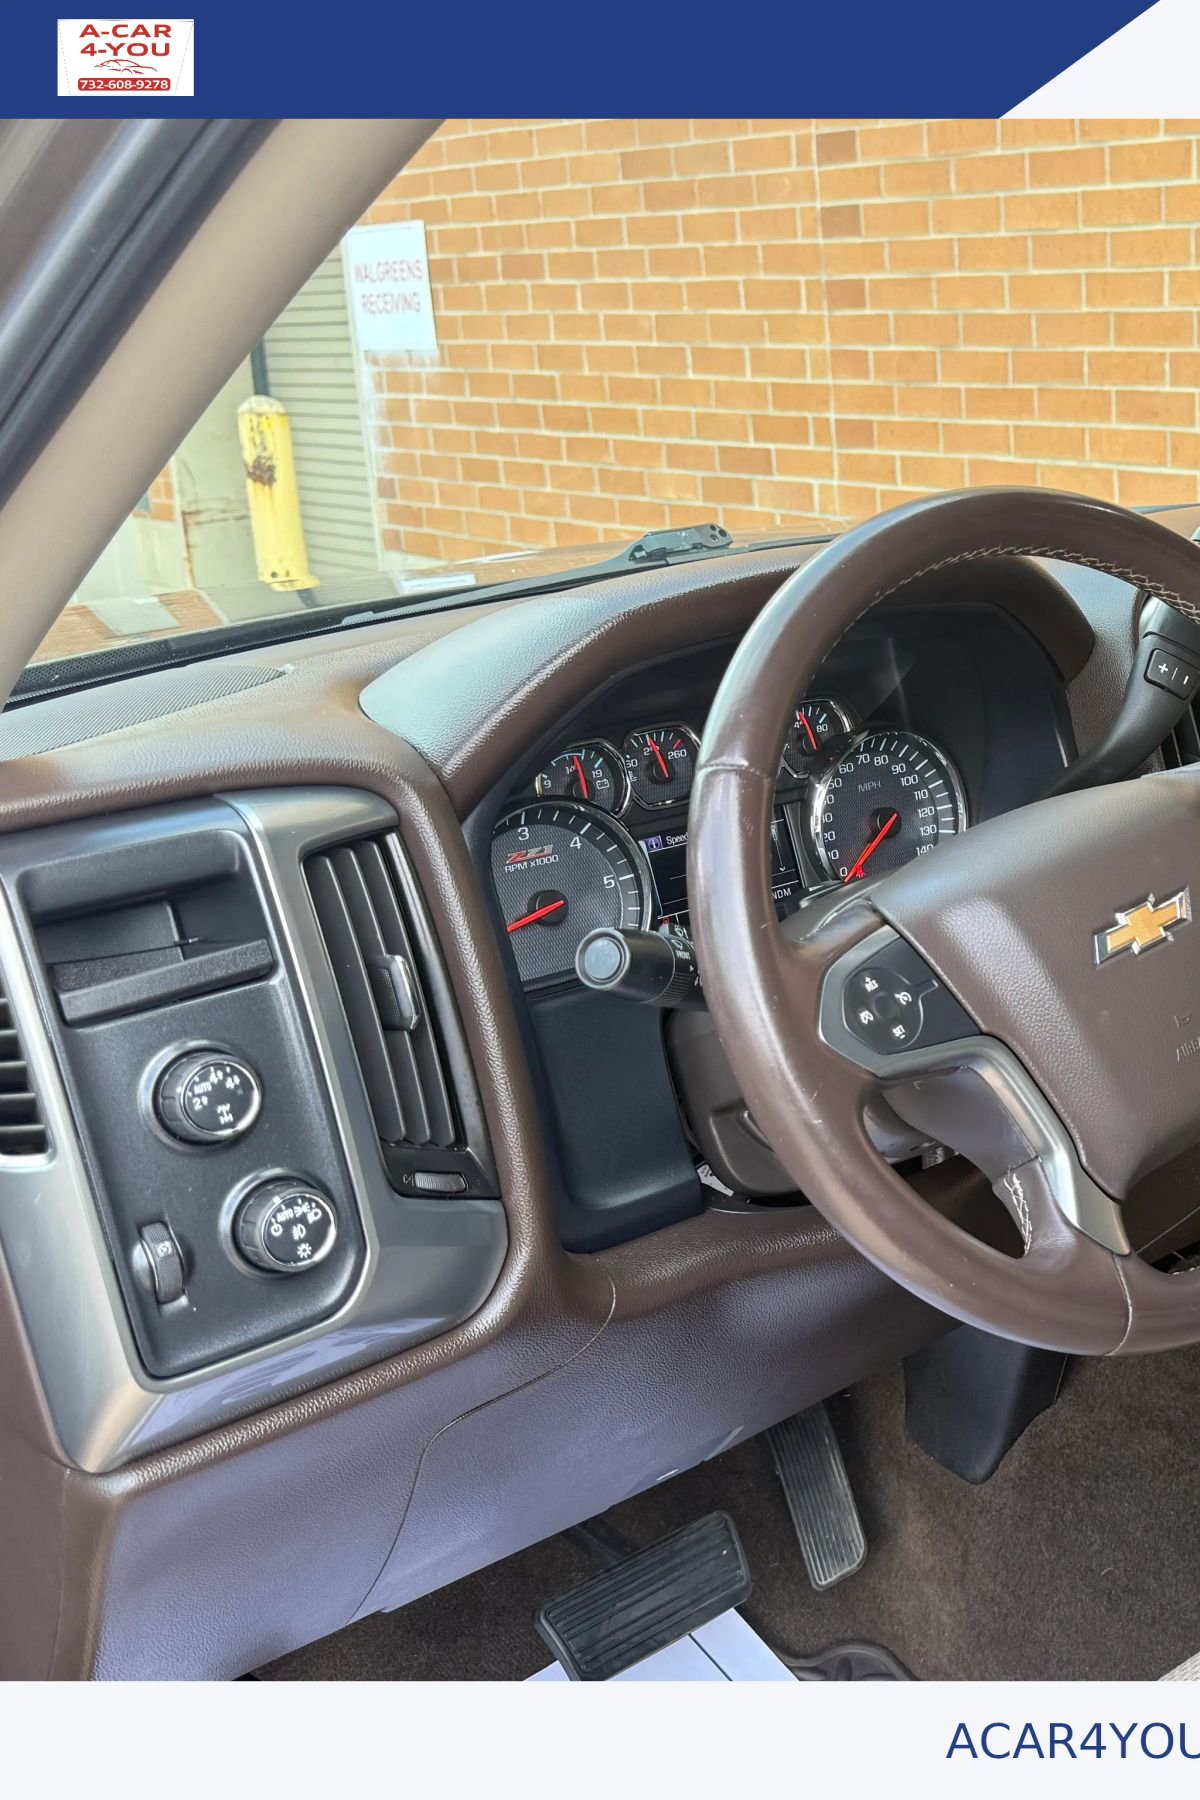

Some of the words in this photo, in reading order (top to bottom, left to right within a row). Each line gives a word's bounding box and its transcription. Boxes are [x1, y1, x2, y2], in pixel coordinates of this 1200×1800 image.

[354, 260, 423, 283] WALGREENS
[361, 291, 421, 314] RECEIVING
[816, 723, 829, 732] 80
[667, 749, 687, 760] 260
[855, 753, 870, 765] 70
[874, 754, 889, 767] 80
[592, 769, 603, 779] 19
[838, 762, 854, 775] 60
[891, 763, 906, 775] 90
[543, 779, 552, 789] 9
[858, 780, 882, 794] MPH
[900, 774, 919, 787] 100
[914, 788, 929, 800] 110
[917, 804, 935, 818] 120
[517, 826, 530, 841] 3
[920, 824, 938, 837] 130
[570, 836, 582, 850] 4
[504, 860, 529, 874] RPM
[529, 854, 560, 868] x1000
[840, 866, 848, 877] 0
[603, 874, 616, 890] 5
[193, 1081, 212, 1094] AUTO
[276, 1210, 294, 1222] AUTO
